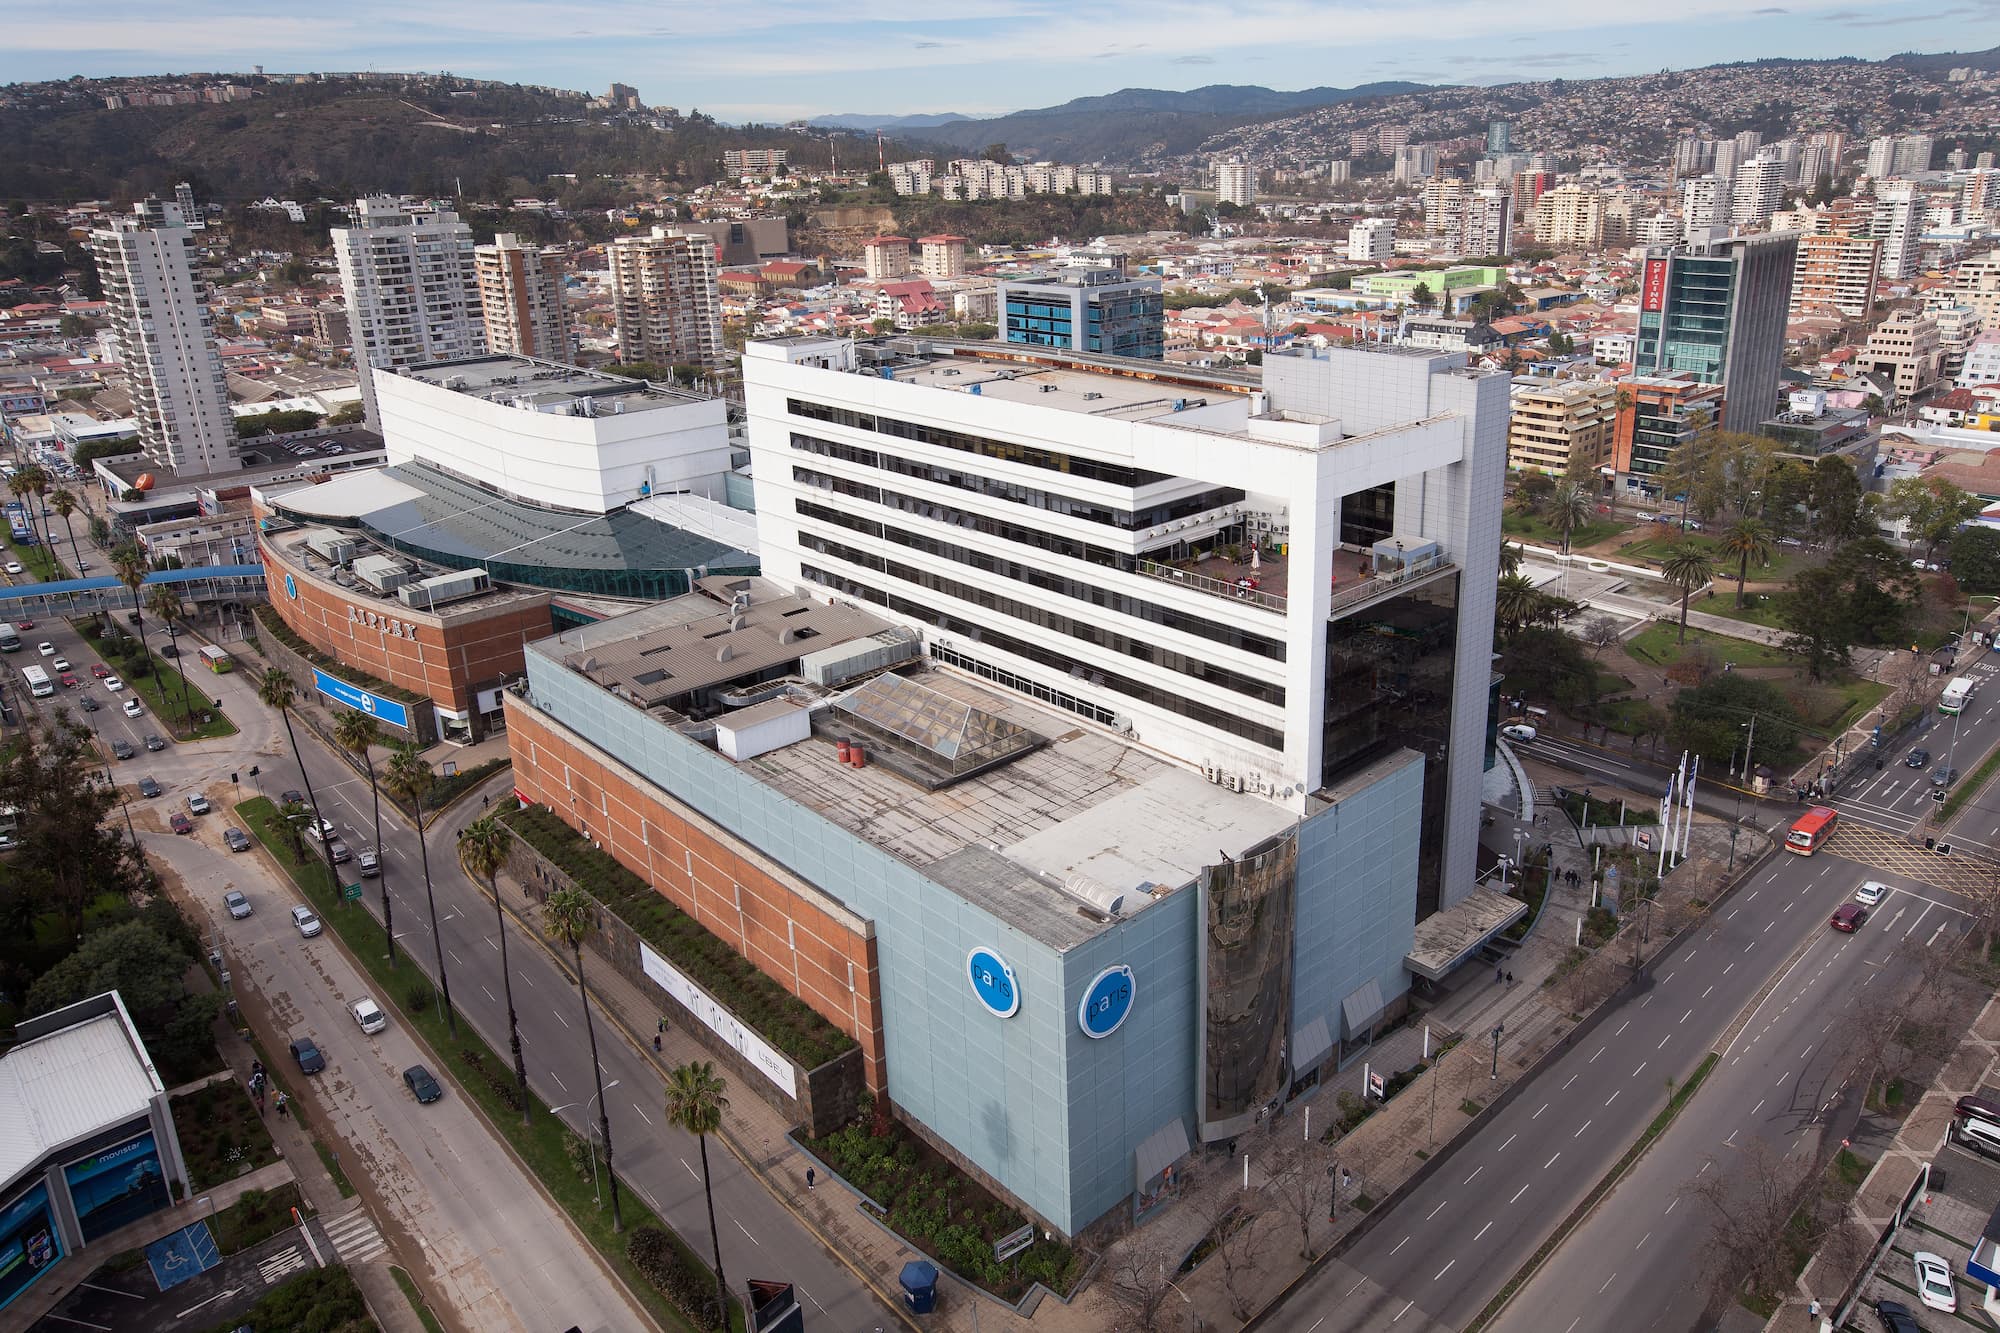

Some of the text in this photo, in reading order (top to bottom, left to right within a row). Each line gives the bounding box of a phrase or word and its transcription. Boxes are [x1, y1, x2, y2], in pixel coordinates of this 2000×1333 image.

[1649, 262, 1662, 309] OFICINAS
[347, 605, 416, 640] RIPLEY
[974, 963, 1010, 998] paris
[1089, 984, 1128, 1024] paris
[99, 1141, 141, 1163] movistar
